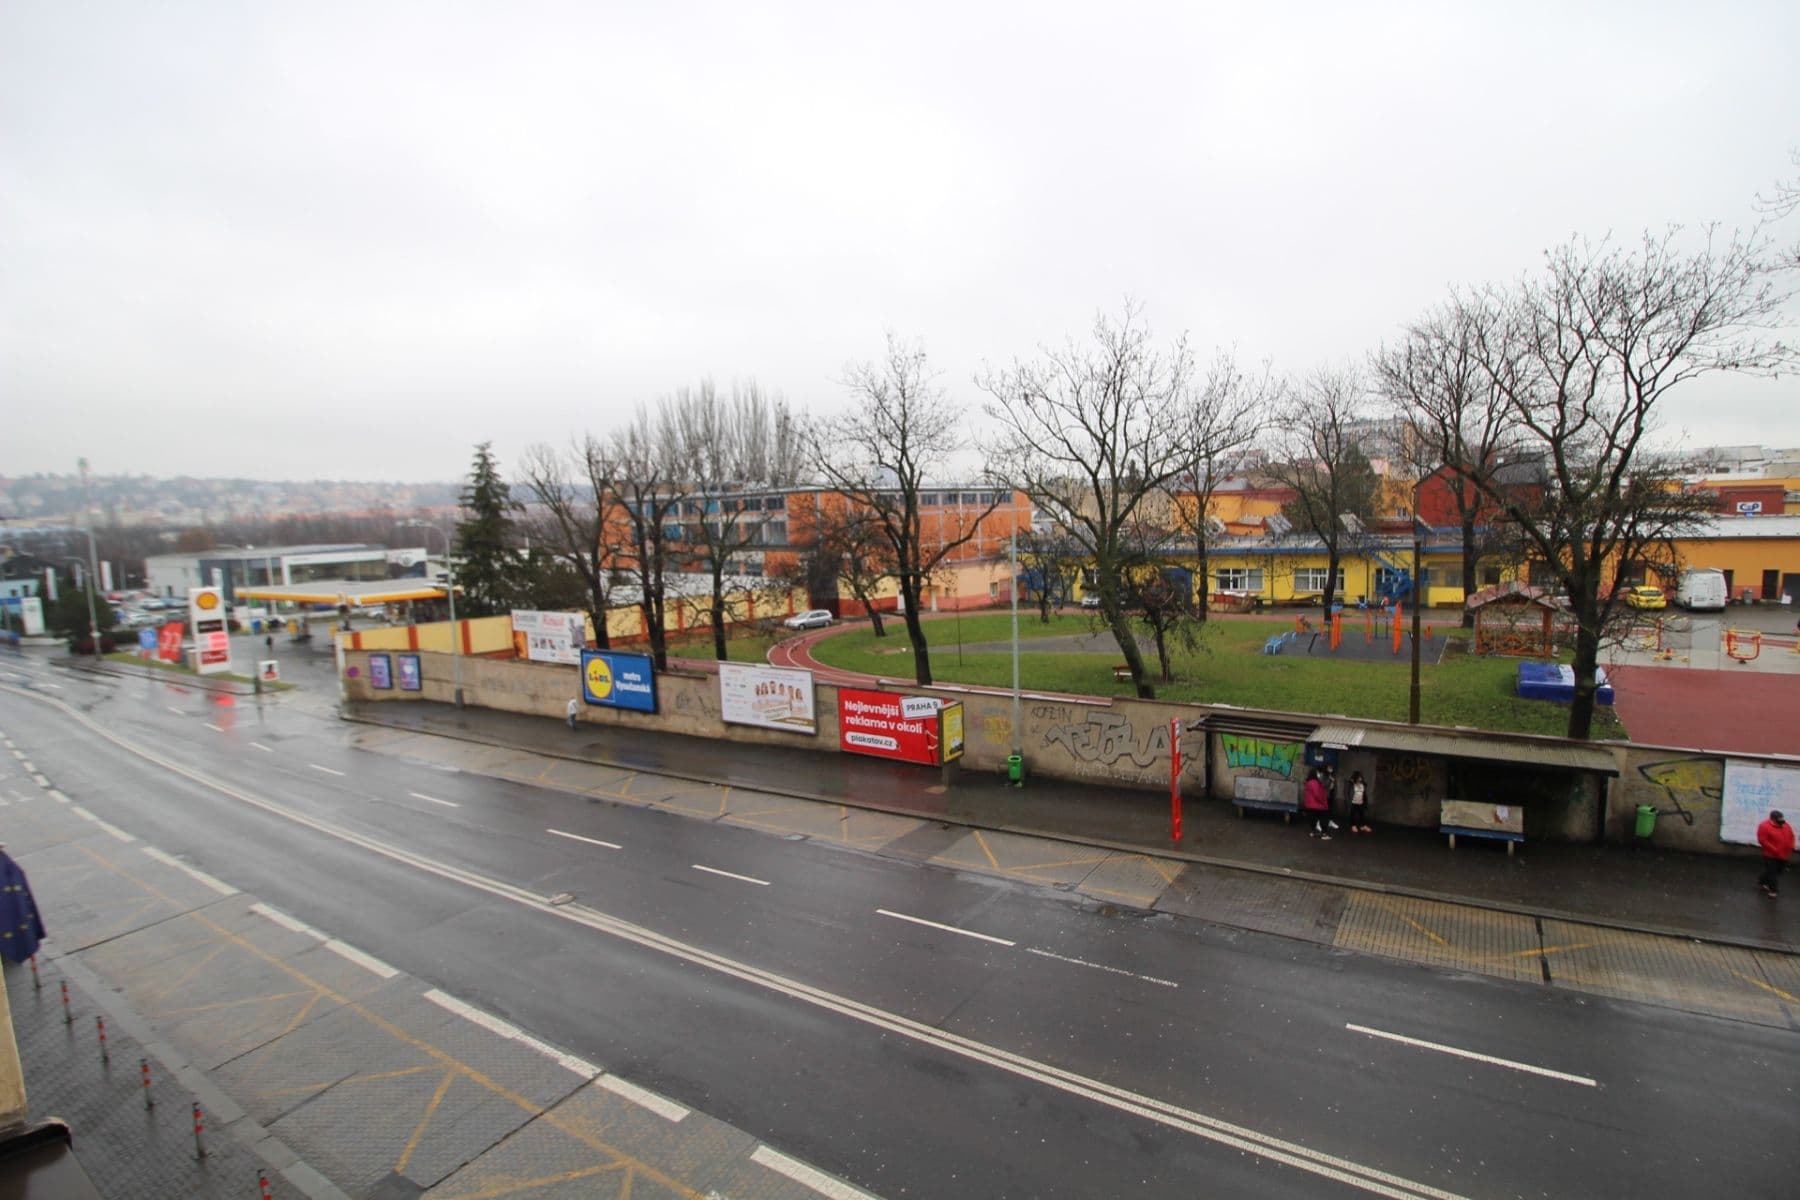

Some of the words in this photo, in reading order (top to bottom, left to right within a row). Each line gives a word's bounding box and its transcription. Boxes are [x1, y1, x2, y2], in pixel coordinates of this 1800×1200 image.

[589, 670, 611, 683] LIDL
[844, 701, 899, 718] Nejlevnější
[906, 702, 932, 711] PRAHA
[845, 715, 888, 729] reklama
[896, 721, 922, 734] okolí
[851, 734, 893, 747] plakatov.cz
